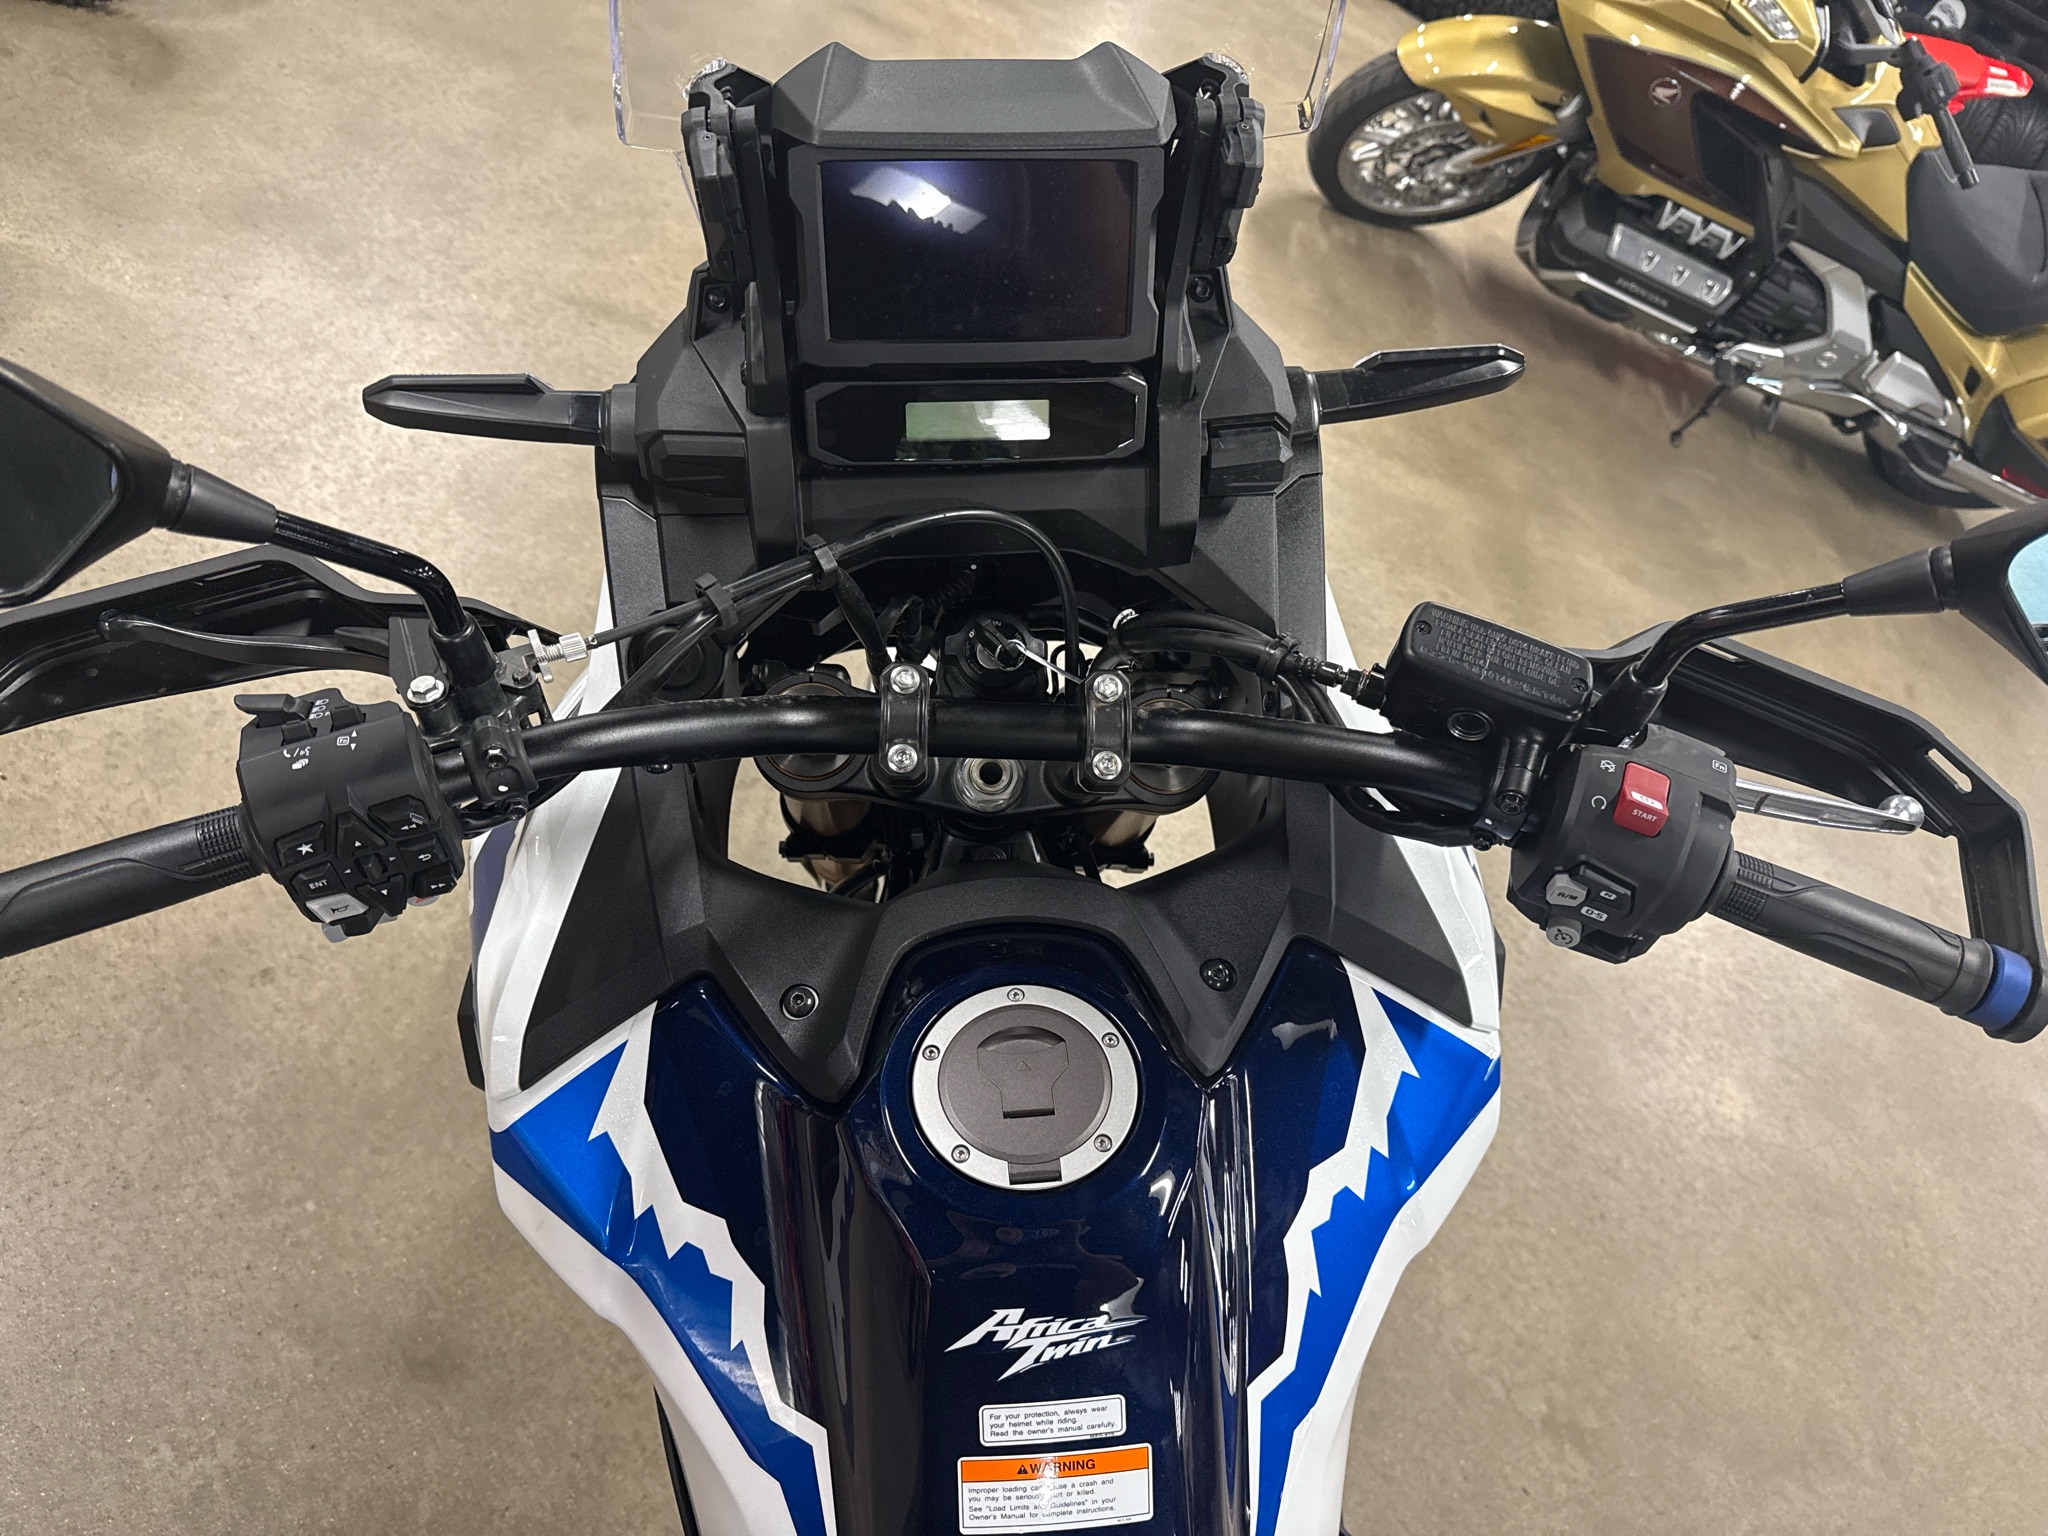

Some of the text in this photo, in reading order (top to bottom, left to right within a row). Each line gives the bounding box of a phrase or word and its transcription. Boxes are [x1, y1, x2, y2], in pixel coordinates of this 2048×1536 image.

[1632, 808, 1658, 823] START
[309, 879, 328, 890] ENT
[944, 1307, 1148, 1352] Africa
[997, 1331, 1136, 1381] Twin
[1005, 1413, 1020, 1421] your
[1024, 1410, 1060, 1420] protection,
[1009, 1420, 1032, 1428] helmet
[1058, 1417, 1078, 1425] riding.
[1027, 1427, 1054, 1435] owner's
[1058, 1424, 1083, 1433] manual
[1029, 1458, 1096, 1474] WARNING
[1079, 1480, 1098, 1488] crash
[1101, 1478, 1114, 1486] and
[1077, 1488, 1096, 1496] killed.
[1050, 1499, 1088, 1509] Guidelines"
[1101, 1497, 1116, 1505] your
[1077, 1505, 1115, 1515] instructions.
